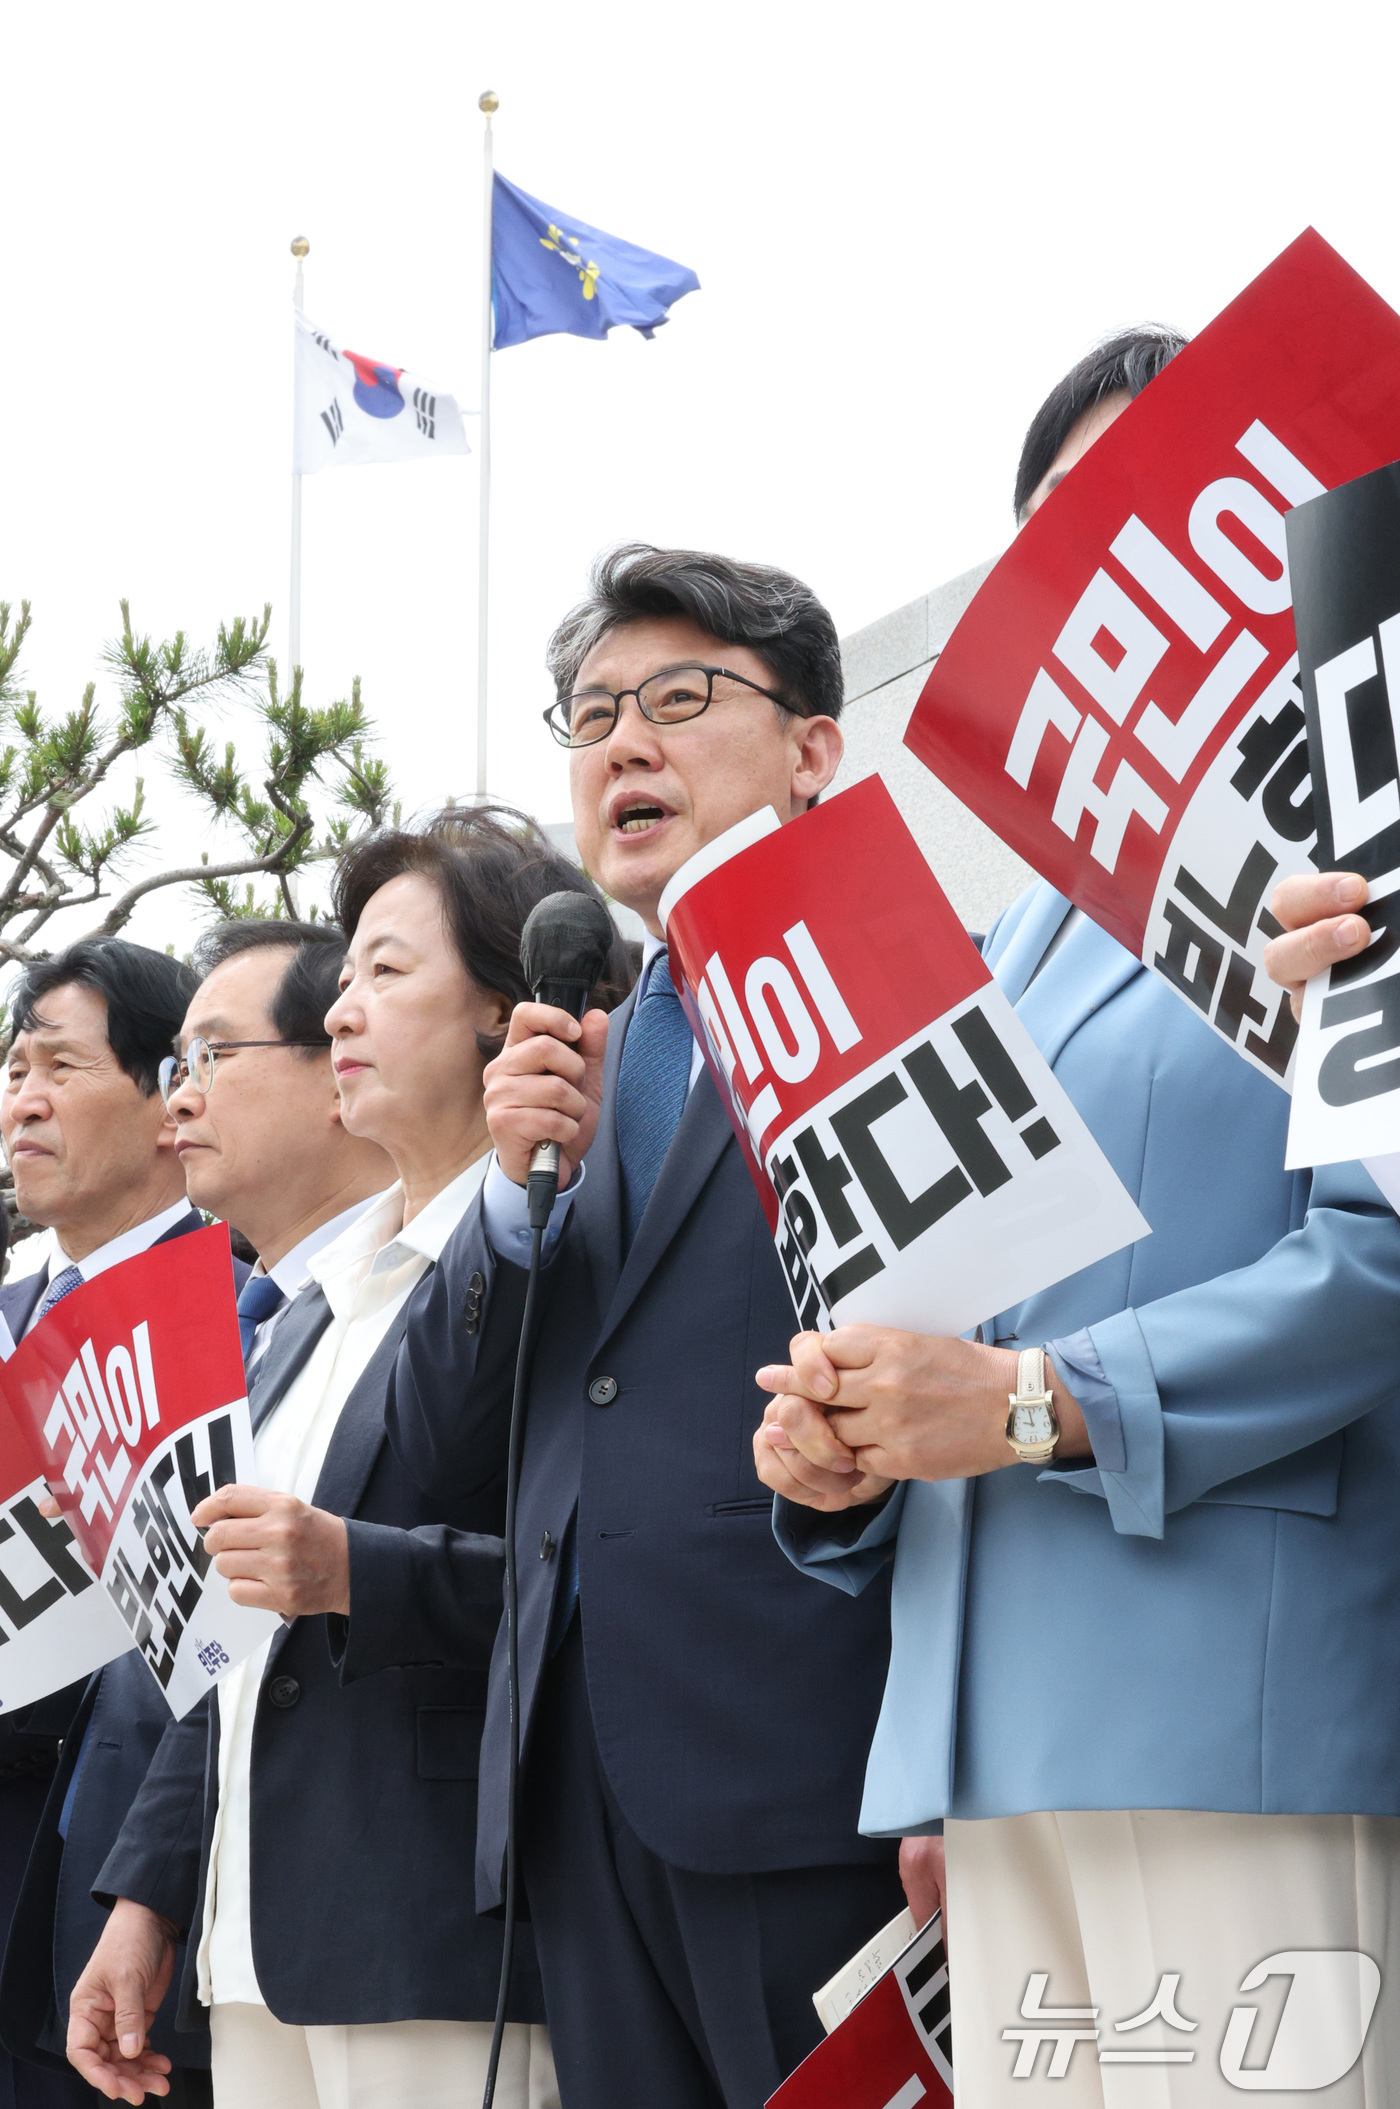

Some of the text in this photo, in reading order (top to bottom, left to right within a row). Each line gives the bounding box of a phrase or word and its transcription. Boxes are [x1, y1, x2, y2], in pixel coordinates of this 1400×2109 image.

[1004, 418, 1329, 875] 국민이
[686, 919, 863, 1166] 민이
[43, 1320, 160, 1526] 국민이
[197, 1639, 230, 1676] 민주당
